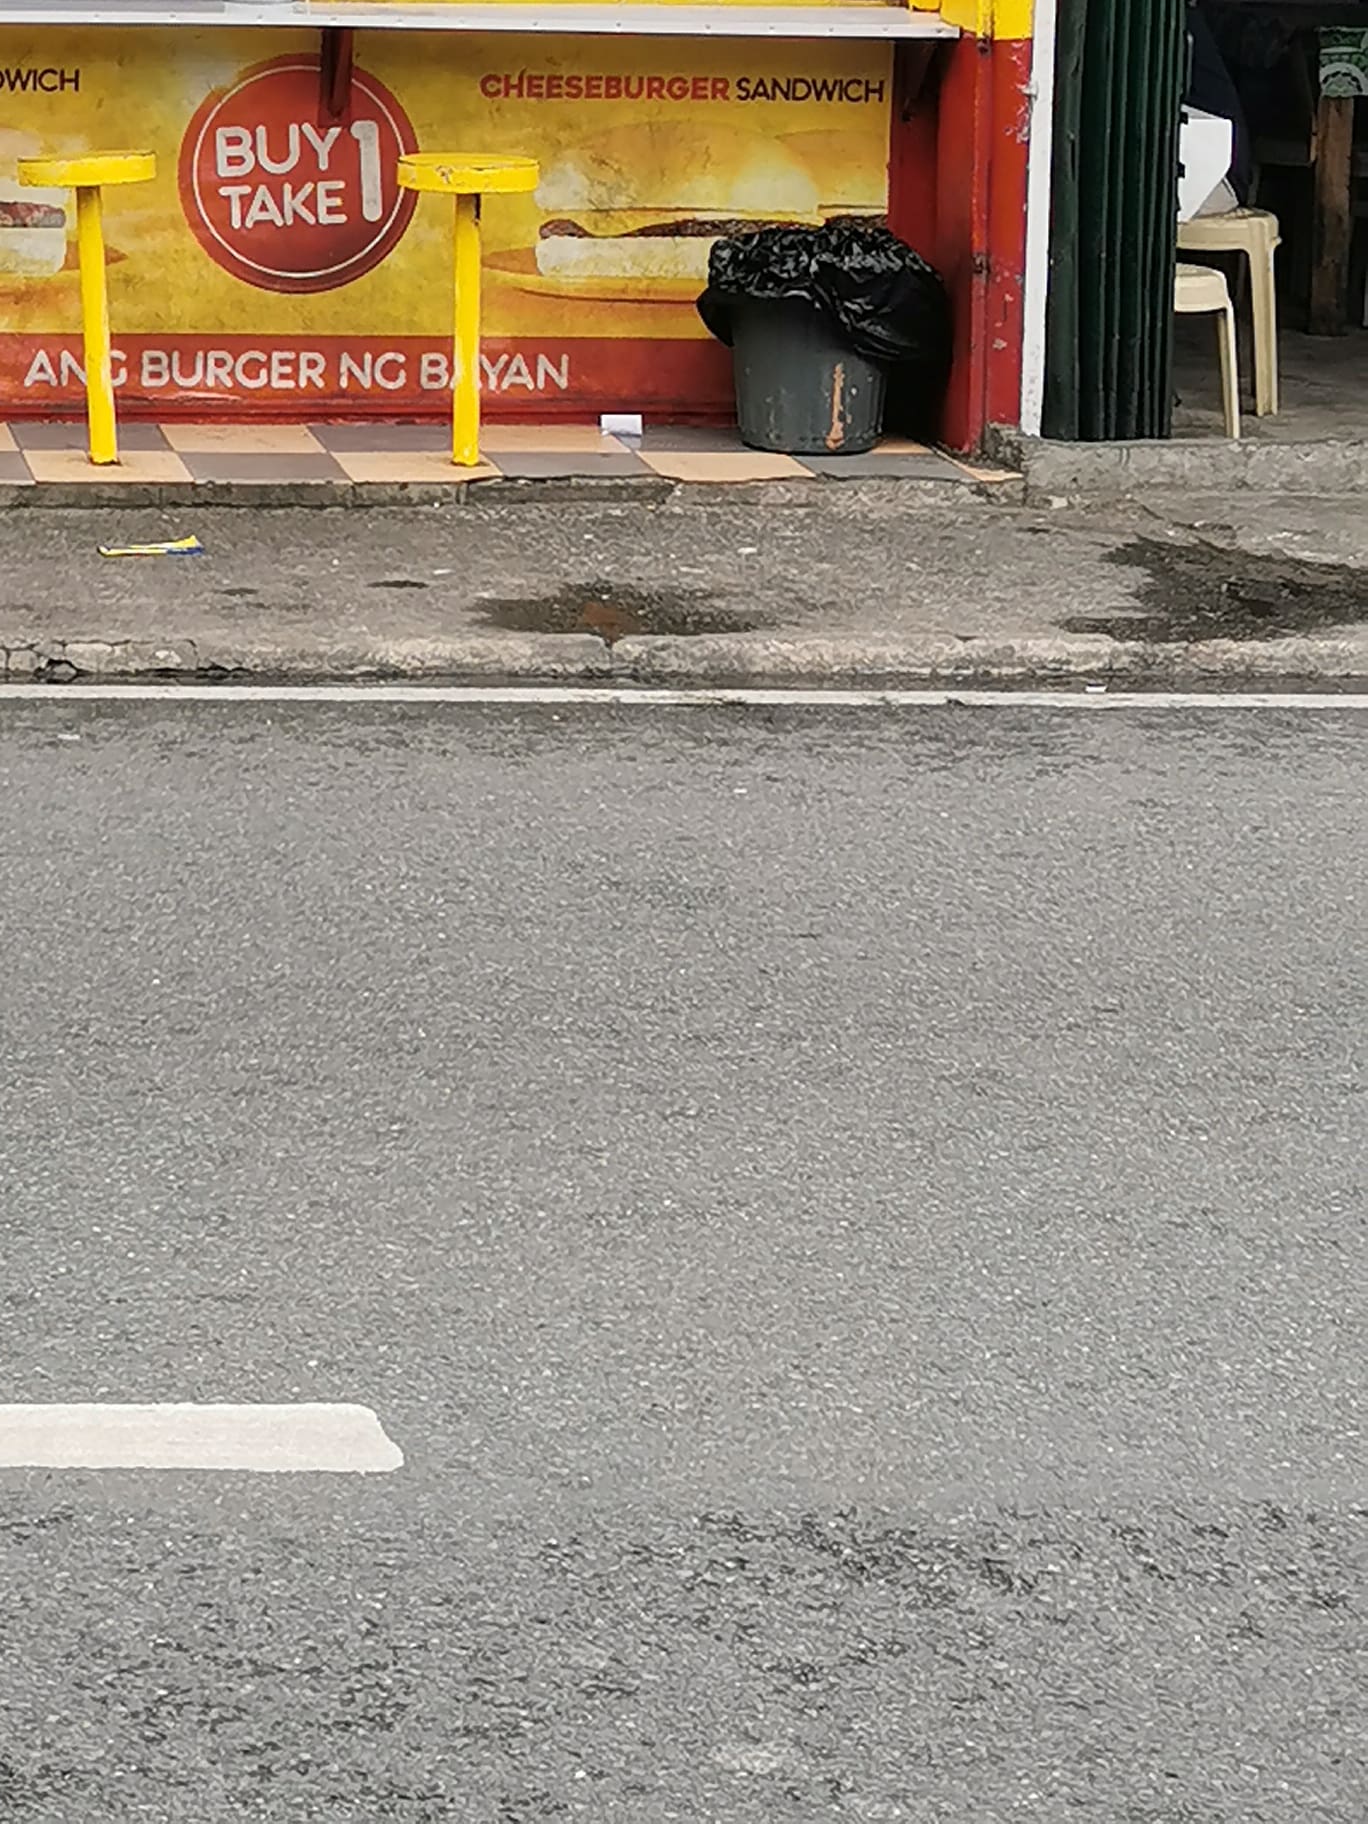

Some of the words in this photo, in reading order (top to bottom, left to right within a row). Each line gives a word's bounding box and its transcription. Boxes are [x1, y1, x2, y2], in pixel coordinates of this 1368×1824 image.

[478, 72, 730, 101] CHEESEBURGER
[736, 75, 885, 104] SANDWICH
[215, 122, 342, 178] BUY
[350, 120, 383, 222] 1
[218, 180, 348, 229] TAKE
[140, 349, 326, 390] BURGER
[338, 351, 406, 390] NG
[419, 352, 569, 391] BYAN
